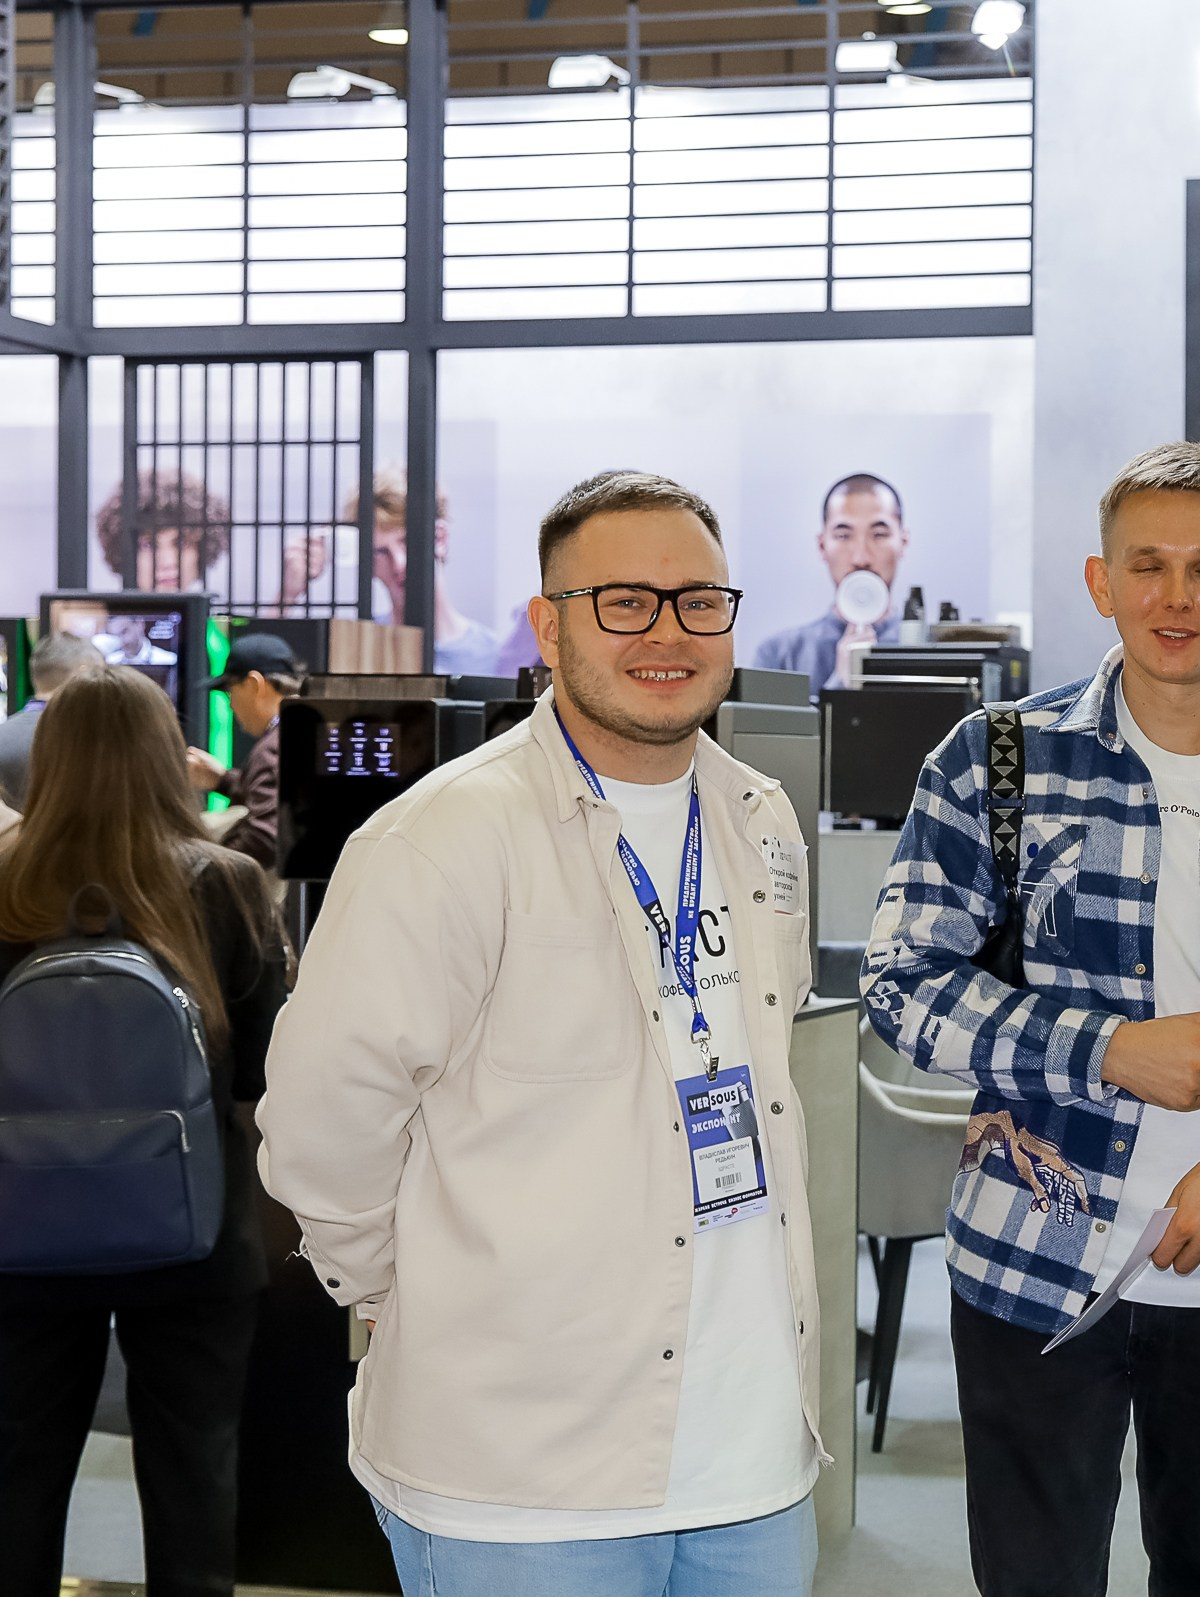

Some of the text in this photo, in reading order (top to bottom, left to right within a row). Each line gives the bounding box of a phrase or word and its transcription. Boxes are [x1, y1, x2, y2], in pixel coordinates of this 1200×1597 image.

[1170, 804, 1200, 818] O'Polo
[689, 1090, 737, 1111] VERSOUS
[691, 1112, 741, 1134] ЭКСПОННТ
